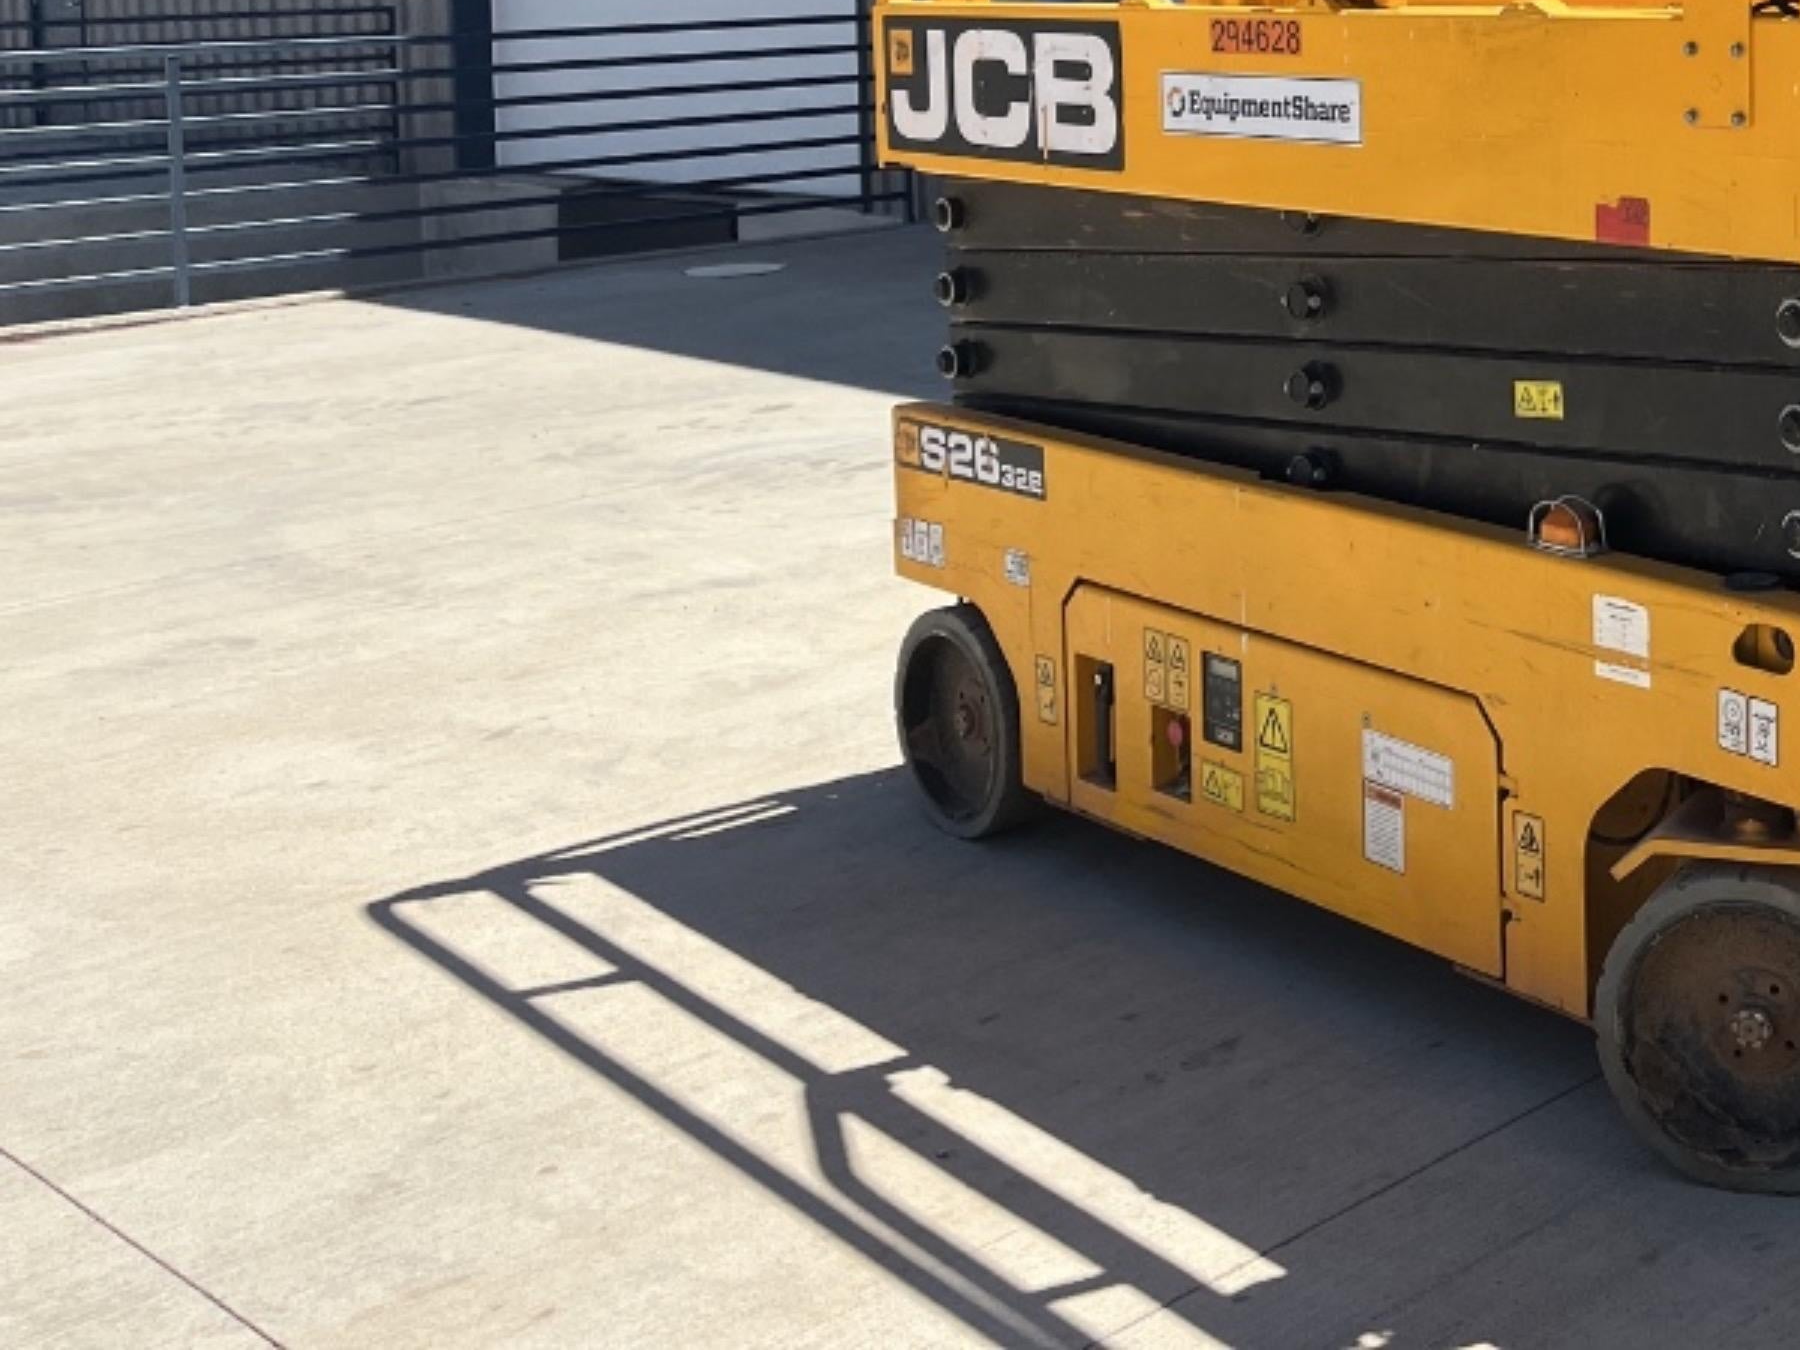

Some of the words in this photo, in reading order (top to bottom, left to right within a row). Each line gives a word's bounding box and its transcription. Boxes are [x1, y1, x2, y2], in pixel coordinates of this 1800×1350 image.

[1211, 18, 1301, 55] 294628
[890, 29, 1118, 154] JCB
[1188, 89, 1351, 124] EquipmentShare
